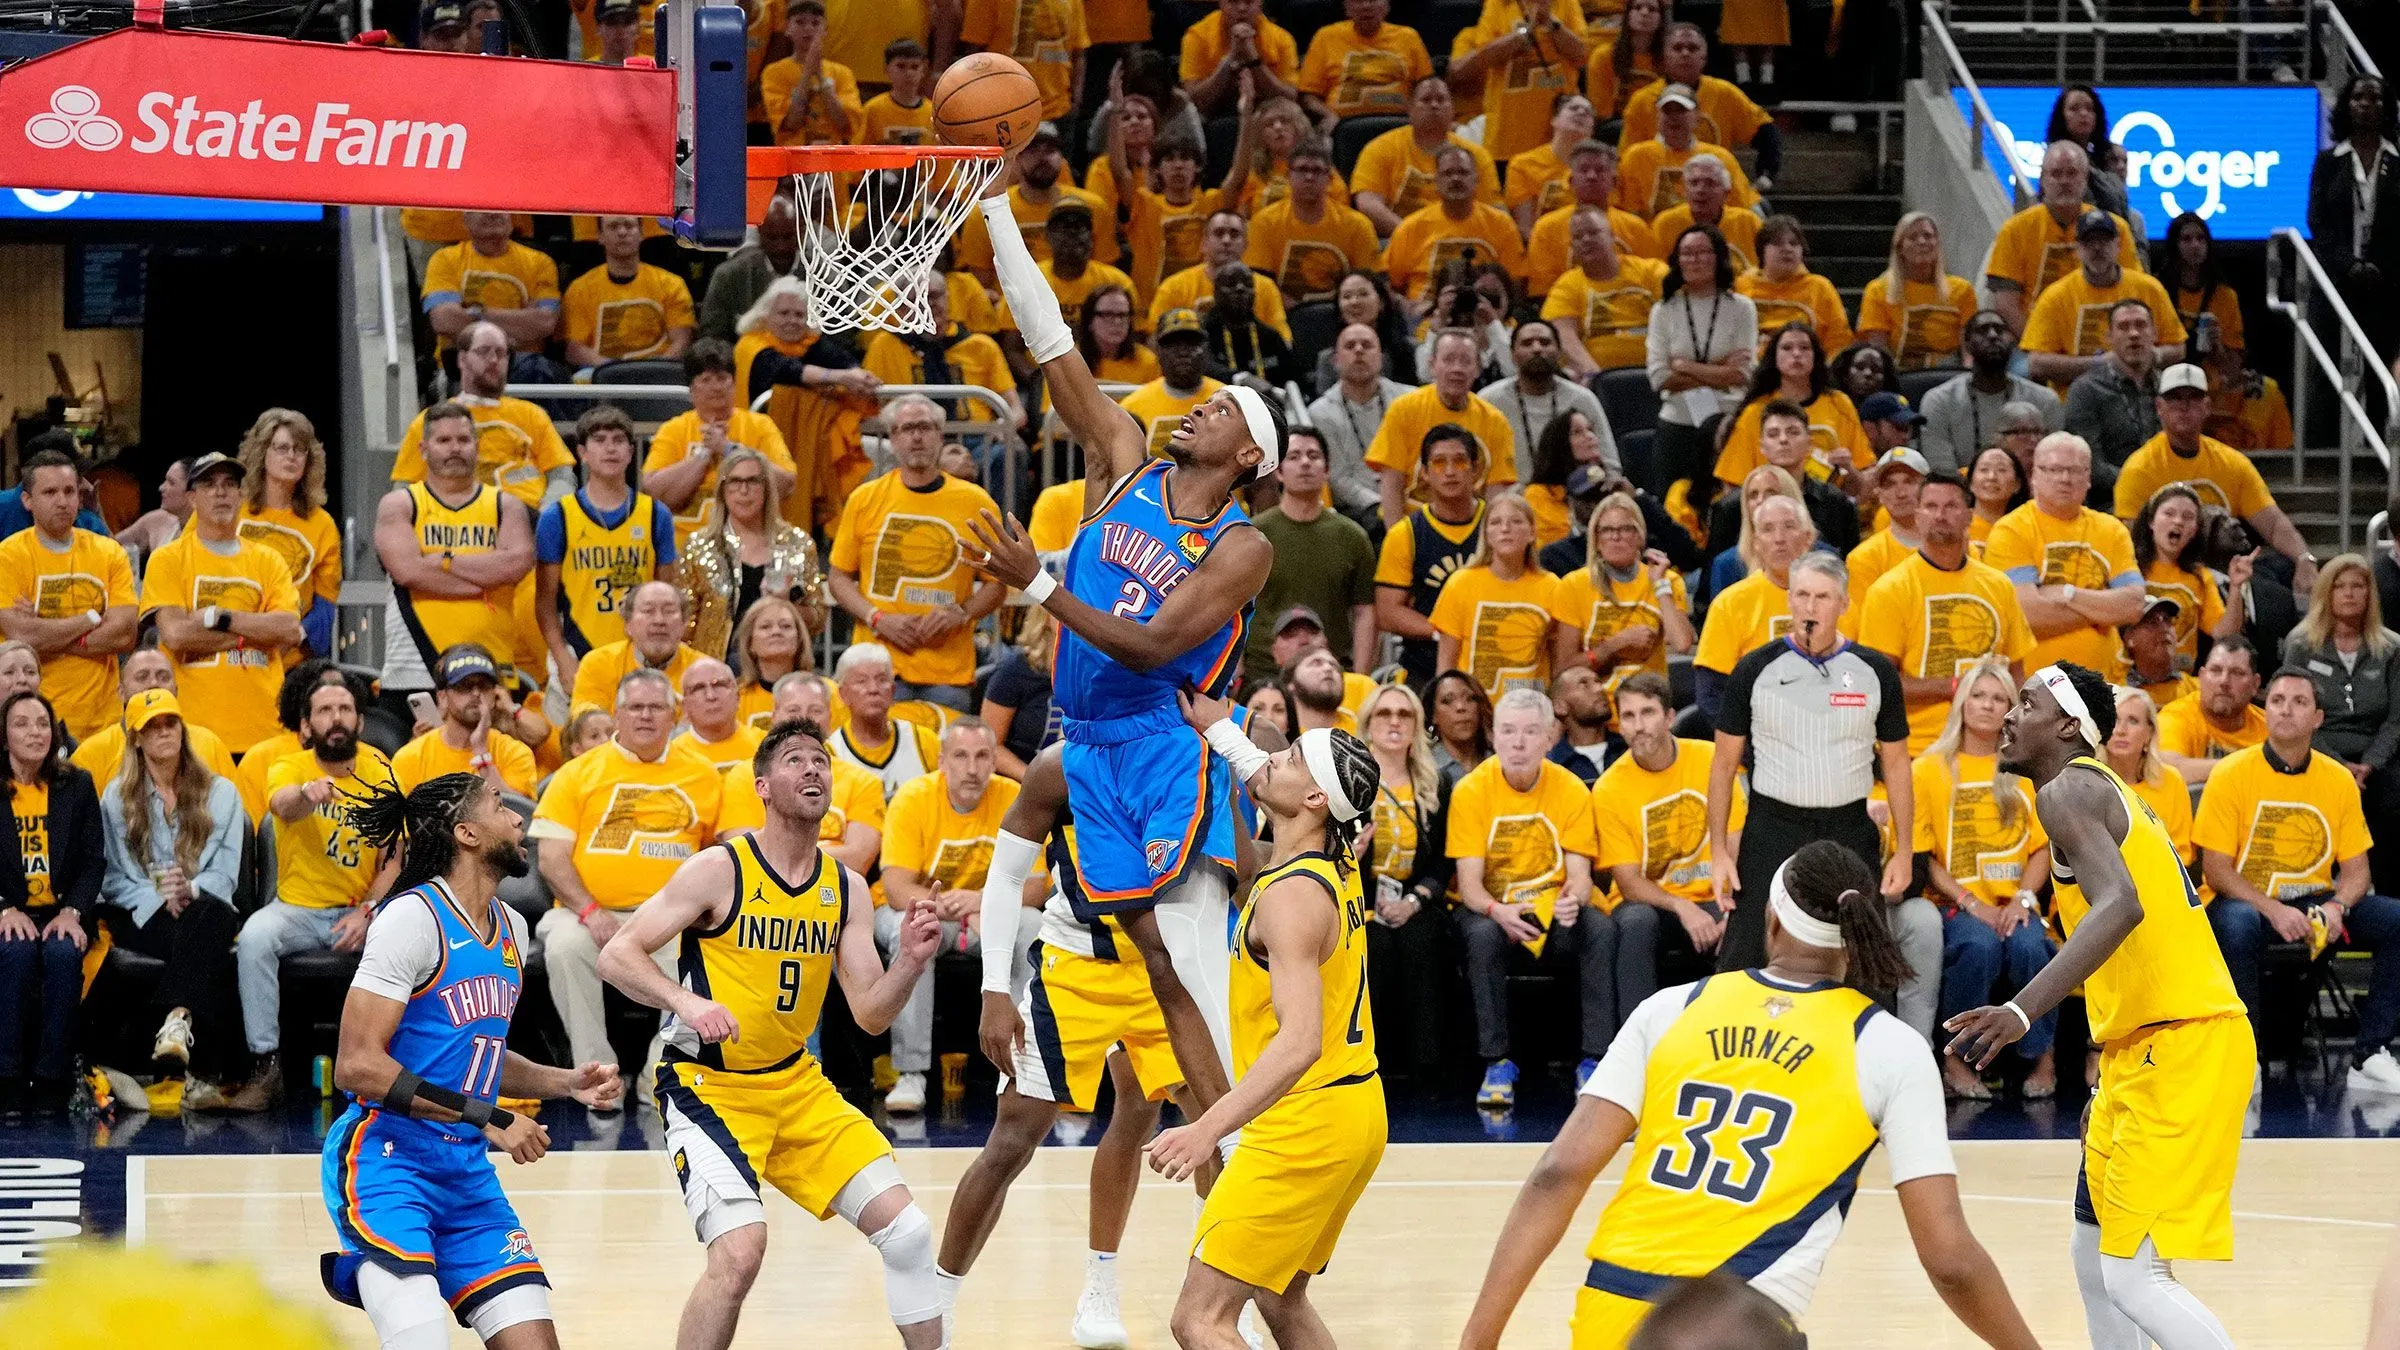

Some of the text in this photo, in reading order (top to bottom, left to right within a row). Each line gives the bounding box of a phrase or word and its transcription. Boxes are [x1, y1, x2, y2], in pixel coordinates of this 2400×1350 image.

[424, 525, 497, 549] INDIANA
[573, 546, 649, 570] INDIANA
[1101, 523, 1192, 600] THUNDE
[595, 577, 632, 612] 3
[1112, 579, 1149, 622] 2
[737, 914, 839, 955] INDIANA
[438, 976, 520, 1028] THUNDE
[775, 960, 801, 1013] 9
[462, 1035, 504, 1097] 11
[1706, 1026, 1815, 1074] TURNER
[1650, 1081, 1793, 1203] 33
